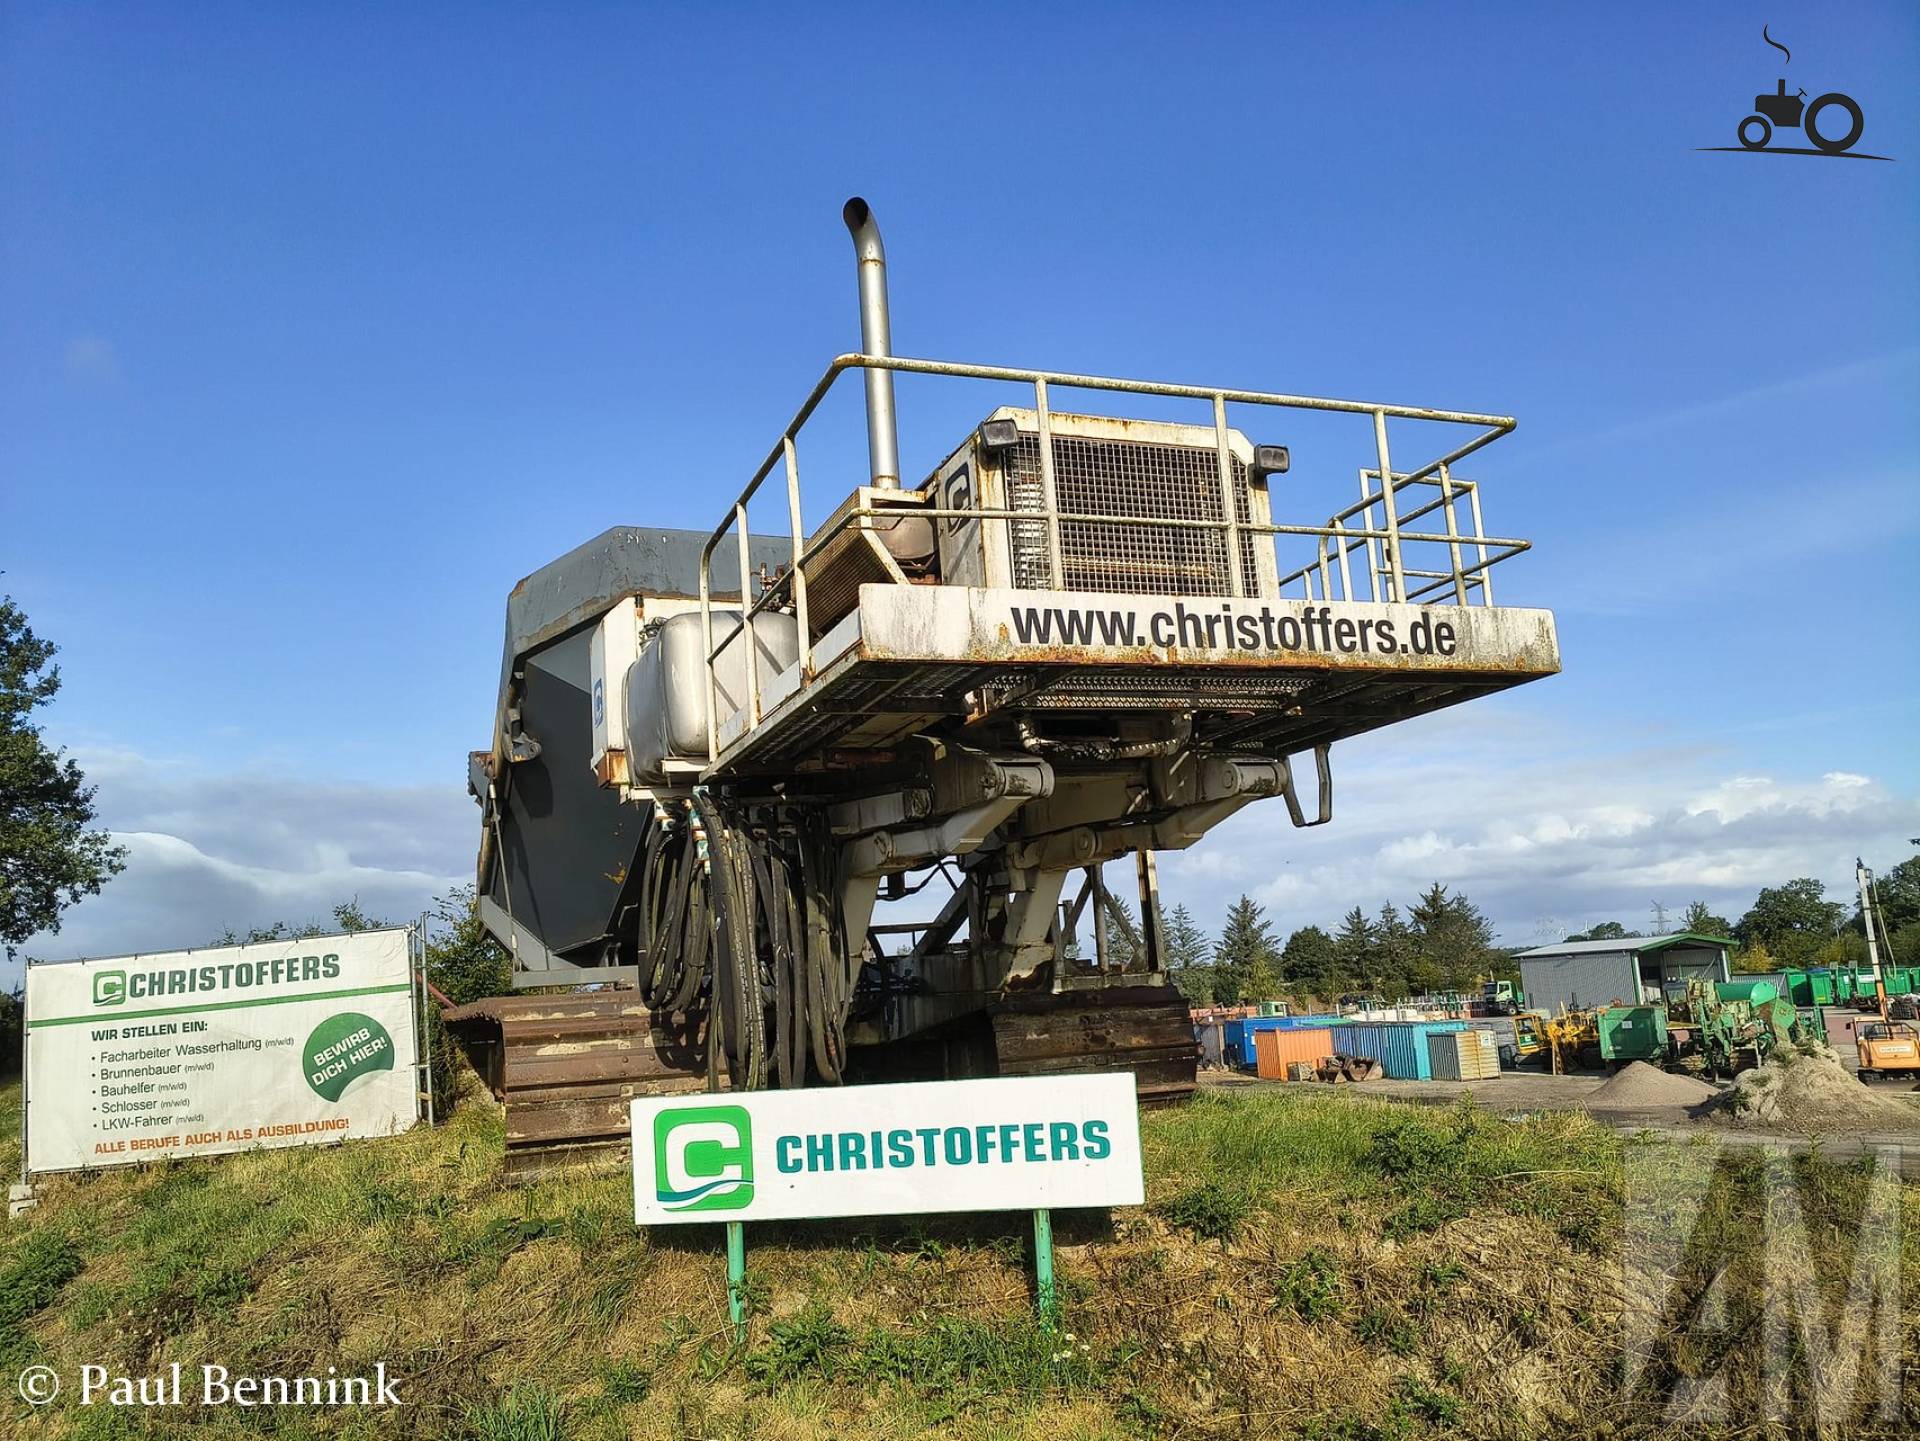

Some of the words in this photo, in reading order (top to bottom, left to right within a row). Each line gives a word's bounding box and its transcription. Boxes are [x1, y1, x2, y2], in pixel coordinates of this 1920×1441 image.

[1011, 602, 1457, 657] www.christoffers.de
[129, 954, 340, 998] CHRISTOFFERS
[91, 1029, 118, 1041] WIR
[122, 1023, 177, 1039] STELLEN
[182, 1020, 208, 1033] EIN:
[100, 1048, 171, 1063] Facharbeiter
[176, 1039, 262, 1056] Wasserhaltung
[311, 1058, 349, 1087] DICH
[348, 1036, 388, 1066] HIER!
[313, 1027, 372, 1067] BEWIRB
[100, 1064, 182, 1080] Brunnenbauer
[185, 1062, 215, 1074] (m/w/d)
[101, 1081, 156, 1097] Bauhelfer
[158, 1081, 188, 1094] (m/w/d)
[101, 1099, 158, 1114] Schlosser
[160, 1098, 191, 1110] (m/w/d)
[95, 1141, 126, 1154] ALLE
[130, 1135, 181, 1151] BERUFE
[185, 1131, 222, 1145] AUCH
[226, 1128, 253, 1142] ALS
[257, 1118, 350, 1138] AUSBILDUNG!
[102, 1115, 174, 1130] LKW-Fahrer
[776, 1120, 1112, 1174] CHRISTOFFERS
